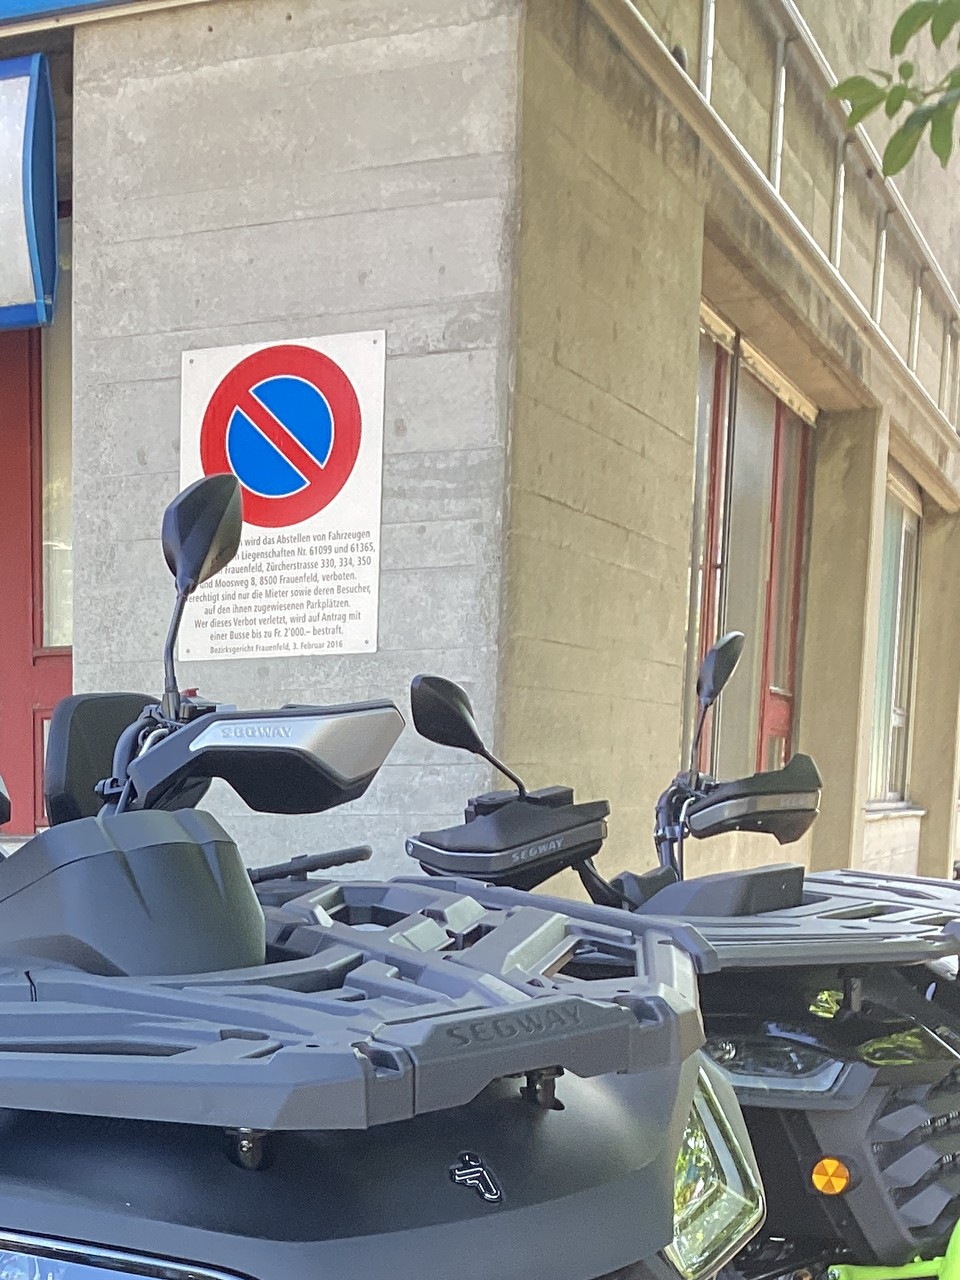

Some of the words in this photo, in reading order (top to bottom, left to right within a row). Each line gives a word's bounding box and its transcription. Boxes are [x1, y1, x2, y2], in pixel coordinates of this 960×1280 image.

[244, 535, 261, 546] wird
[262, 535, 275, 545] das
[276, 533, 311, 545] Abstellen
[312, 533, 326, 542] von
[328, 530, 371, 541] Fahrzeugen
[241, 547, 295, 562] Liegenschaften
[309, 544, 333, 556] 61099
[334, 543, 348, 554] und
[266, 560, 319, 572] Zürcherstrasse
[357, 556, 372, 567] 350
[214, 577, 249, 590] Moosweg
[259, 575, 278, 586] 8500
[279, 573, 320, 584] Frauenfeld,
[187, 592, 220, 604] erechtigt
[221, 590, 236, 601] sind
[237, 591, 250, 600] nur
[251, 589, 263, 599] die
[264, 588, 288, 599] Mieter
[290, 587, 312, 597] sowie
[313, 585, 335, 596] deren
[336, 583, 371, 595] Besucher,
[204, 605, 216, 615] auf
[217, 604, 231, 614] den
[232, 603, 252, 614] ihnen
[253, 601, 305, 614] zugewiesenen
[194, 619, 208, 628] Wer
[209, 617, 232, 628] dieses
[233, 616, 257, 627] Verbot
[289, 612, 307, 623] wird
[308, 612, 321, 622] auf
[321, 612, 347, 623] Antrag
[348, 610, 361, 620] mit
[209, 631, 228, 641] einer
[229, 630, 250, 641] Busse
[251, 628, 262, 639] bis
[263, 630, 273, 638] zu
[300, 640, 325, 650] Februar
[511, 837, 565, 863] SEGWAY
[445, 1004, 584, 1049] SEGWAY
